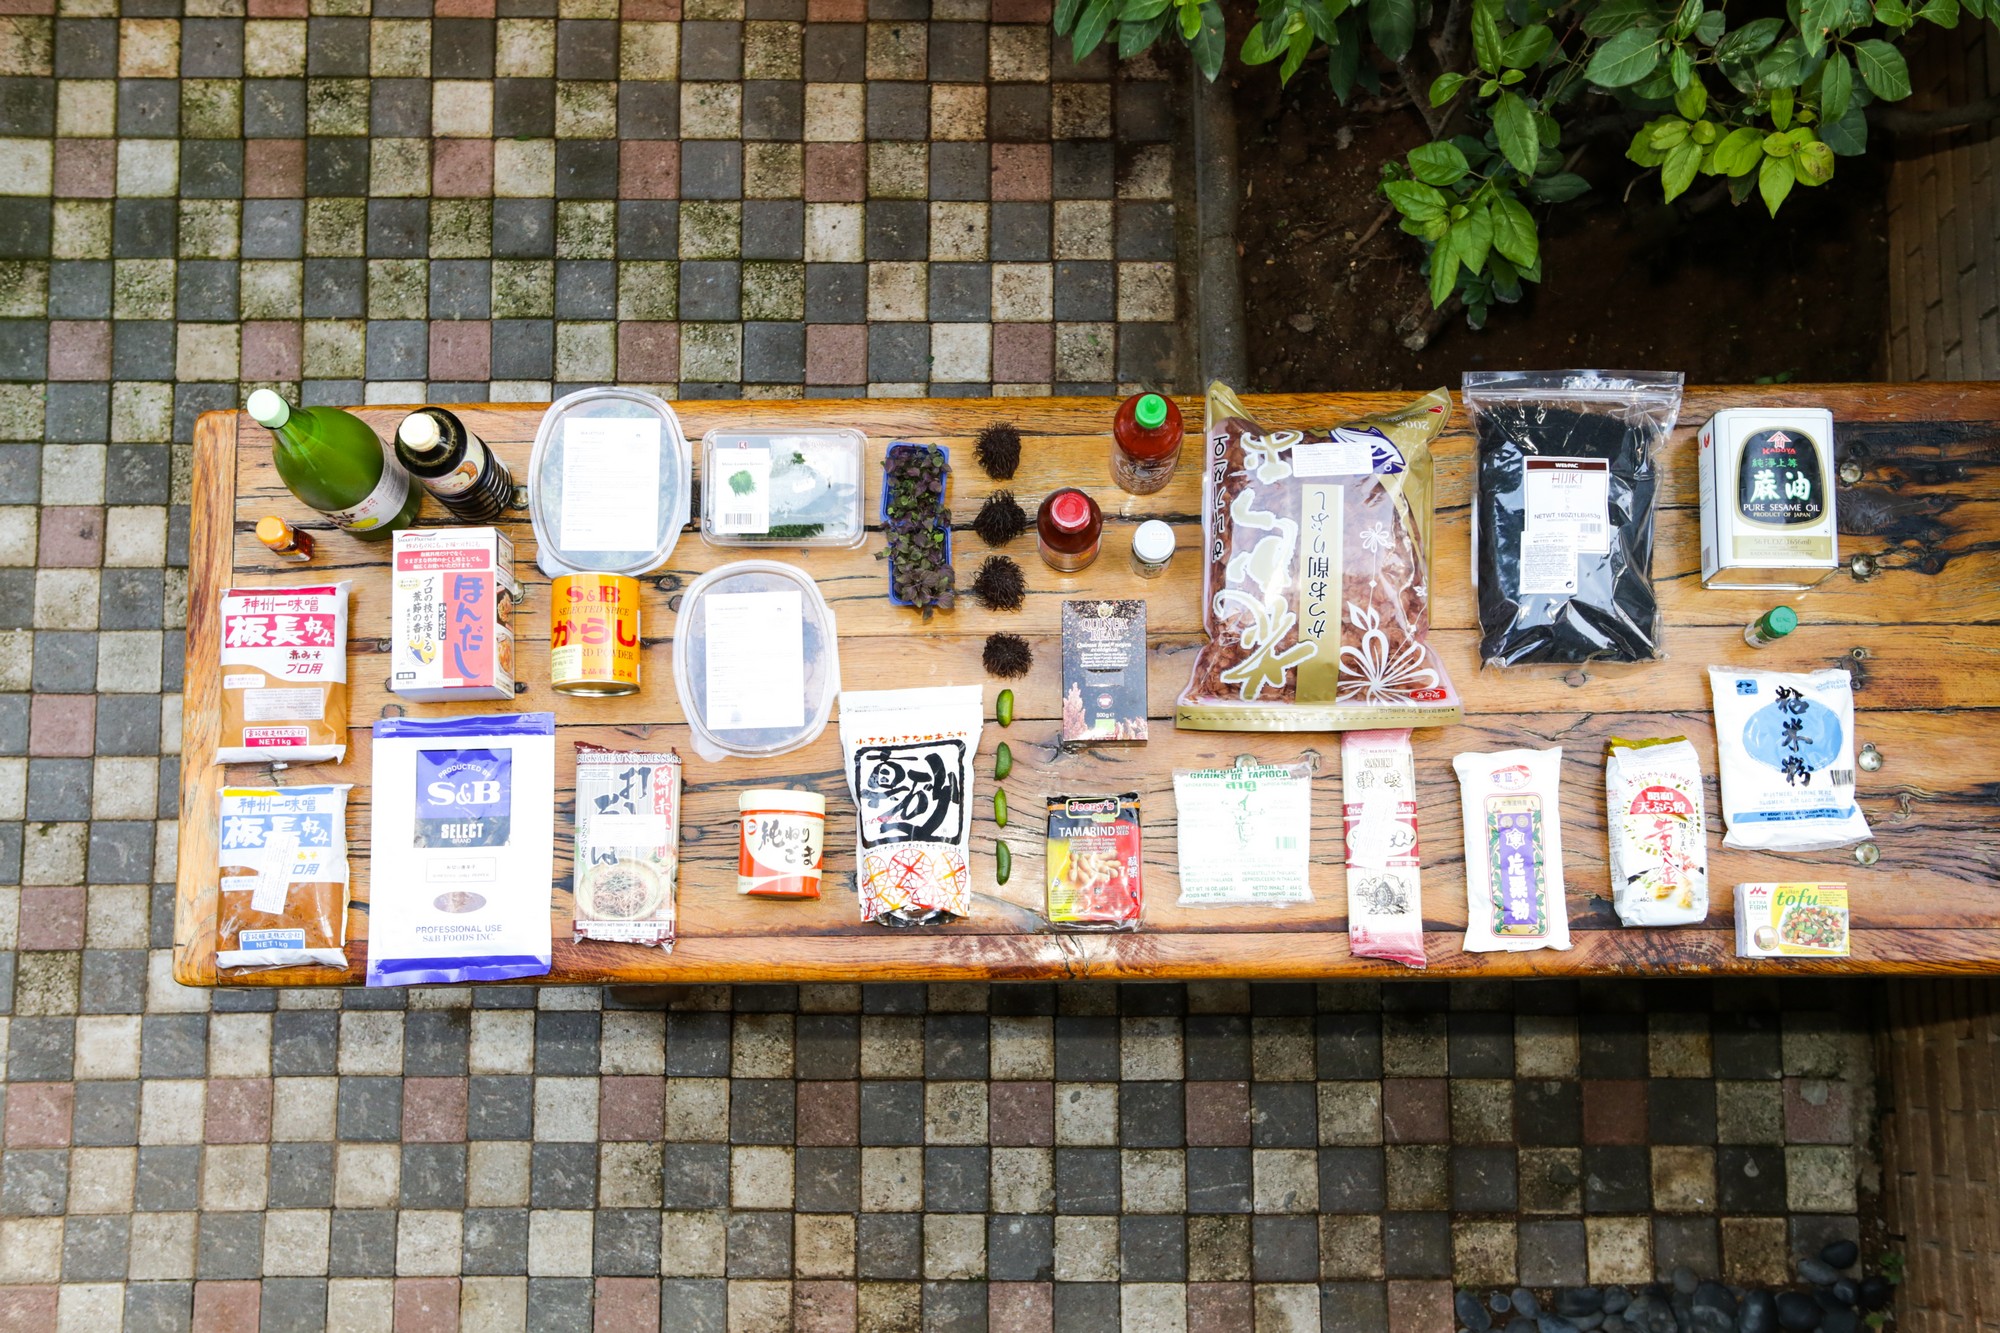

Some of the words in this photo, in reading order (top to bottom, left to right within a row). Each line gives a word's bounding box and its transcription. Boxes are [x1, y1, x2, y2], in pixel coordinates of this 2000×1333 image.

[1552, 473, 1583, 484] HIJIKI
[1212, 436, 1229, 562] 하나가쓰오
[1806, 504, 1820, 512] OIL
[1308, 490, 1329, 640] かつお削りぶし
[242, 597, 318, 613] 神州一味噌
[559, 605, 603, 617] SELECTED
[606, 606, 630, 617] SPICE
[227, 616, 332, 647] 板長好み
[454, 574, 485, 679] ほんだし
[553, 617, 636, 648] からし
[289, 650, 321, 660] 赤みそ
[286, 663, 322, 675] プロ用
[1364, 758, 1394, 768] SANUKI
[438, 764, 482, 779] PRODUCTED
[1249, 770, 1289, 779] TAPIOCA
[428, 781, 501, 806] S&B
[238, 797, 315, 814] 神州一味噌
[1069, 801, 1115, 813] Jeeny's
[441, 823, 484, 839] SELECT
[1059, 826, 1115, 837] TAMARIND
[297, 851, 318, 860] みそ
[291, 863, 320, 875] ロ用
[1507, 853, 1530, 921] 片栗粉
[1776, 888, 1819, 911] tofu
[415, 925, 481, 933] PROFESSIONAL
[485, 924, 502, 932] USE
[423, 934, 441, 942] S&B
[443, 934, 474, 942] FOODS
[275, 941, 288, 949] 1kg
